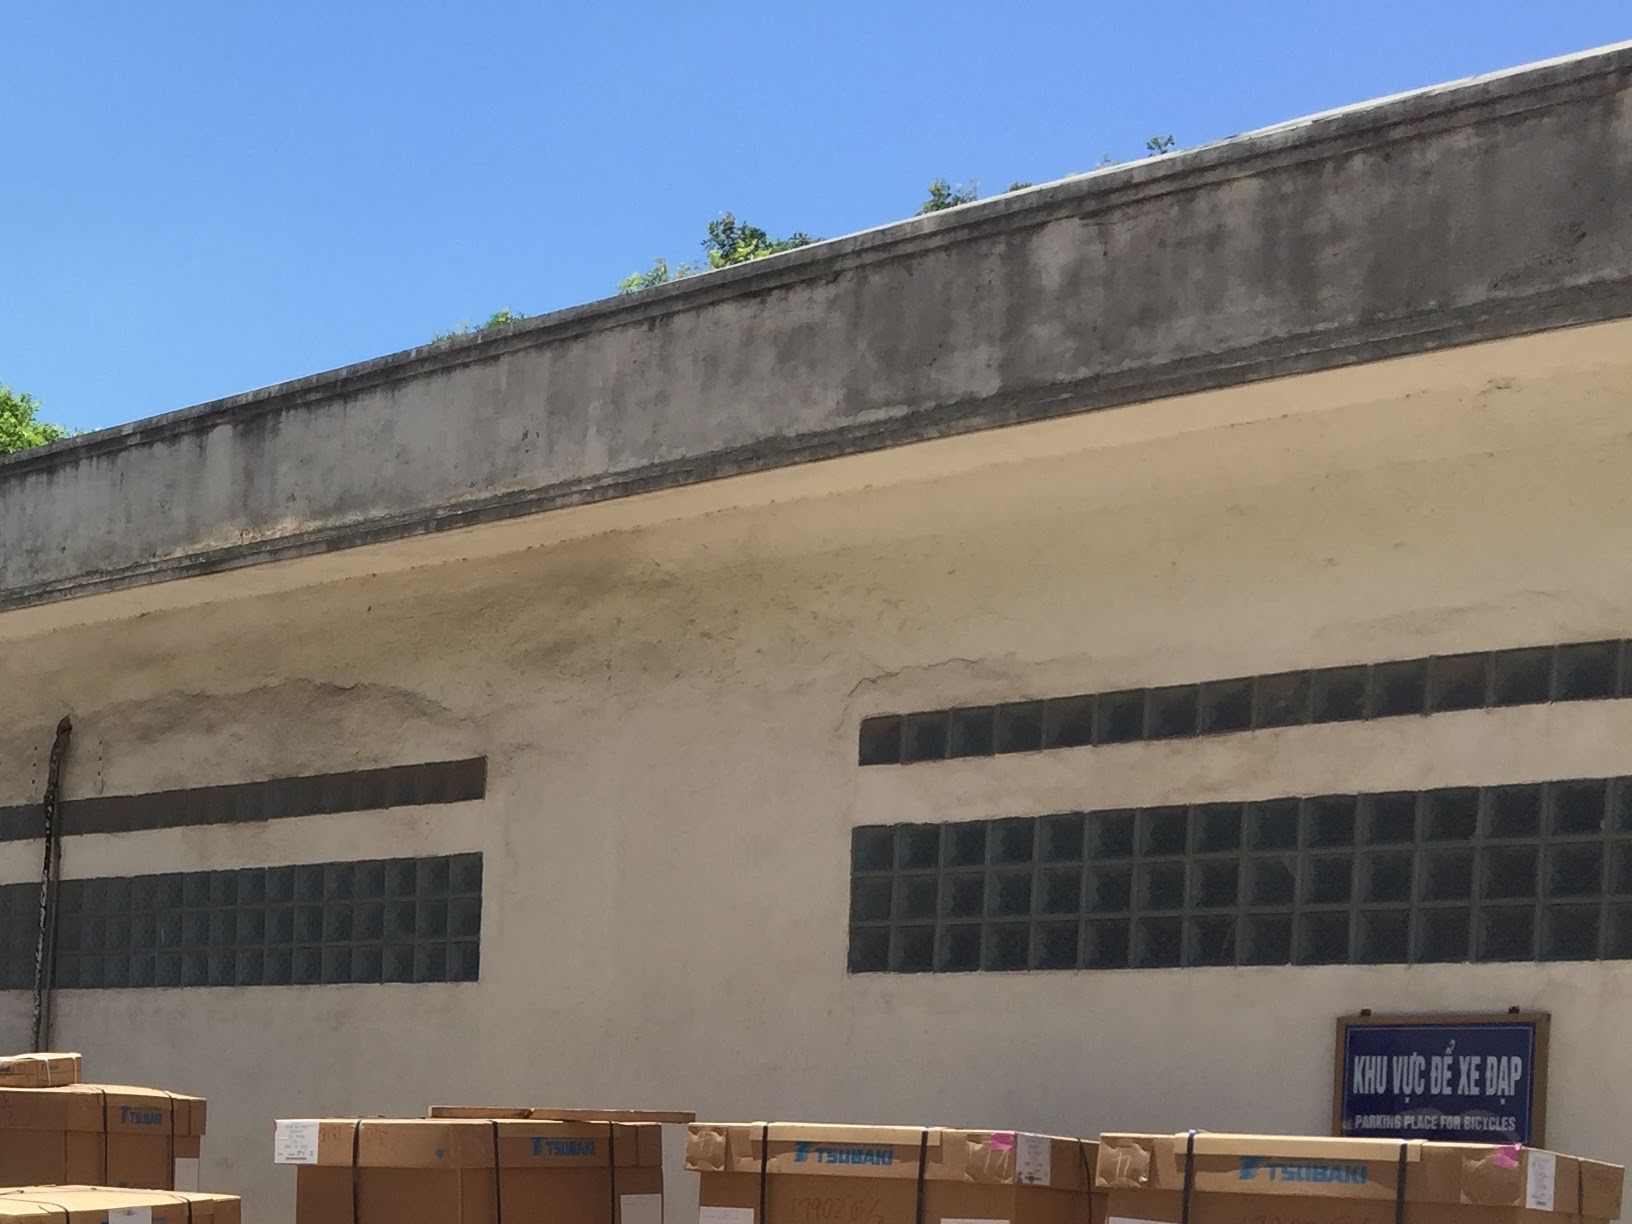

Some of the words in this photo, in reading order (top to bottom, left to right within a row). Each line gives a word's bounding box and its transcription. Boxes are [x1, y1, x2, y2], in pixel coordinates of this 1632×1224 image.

[1352, 1055, 1388, 1094] KHU
[1392, 1052, 1427, 1104] VỰC
[1430, 1039, 1456, 1095] ĐỂ
[1458, 1055, 1481, 1096] XE
[1485, 1055, 1523, 1105] ĐẠP
[1354, 1114, 1401, 1129] PARKING
[1403, 1115, 1439, 1130] PLACE
[1440, 1116, 1461, 1130] FOR
[1463, 1116, 1517, 1131] BICYCLES
[546, 1140, 596, 1156] TSUBAKI
[815, 1147, 894, 1167] TSUBAKI
[1266, 1163, 1369, 1184] TSUBAKI
